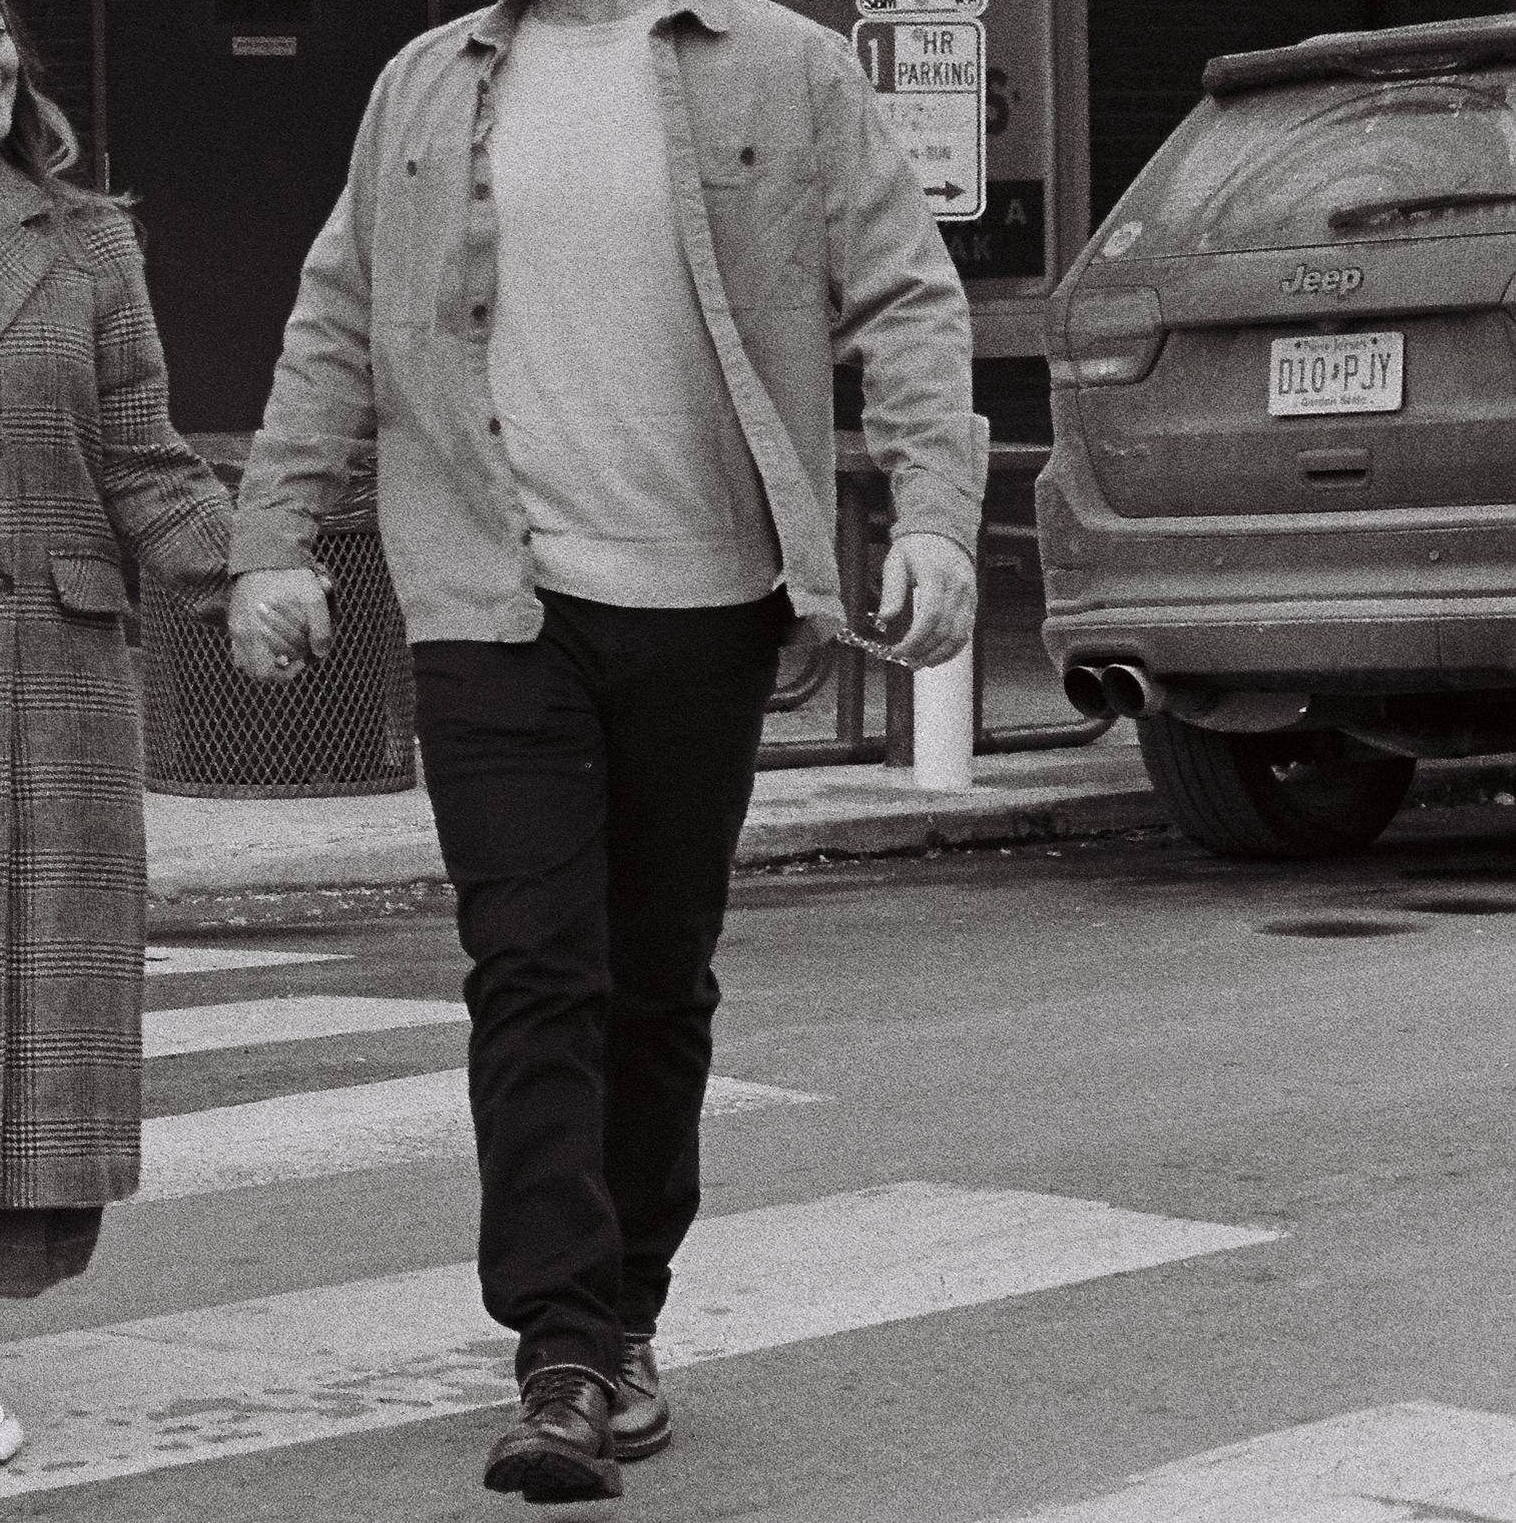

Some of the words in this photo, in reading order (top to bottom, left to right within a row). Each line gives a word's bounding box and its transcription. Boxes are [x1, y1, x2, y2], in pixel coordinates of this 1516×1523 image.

[922, 30, 954, 55] HR
[897, 62, 976, 87] PARKING
[1280, 263, 1365, 301] Jeep
